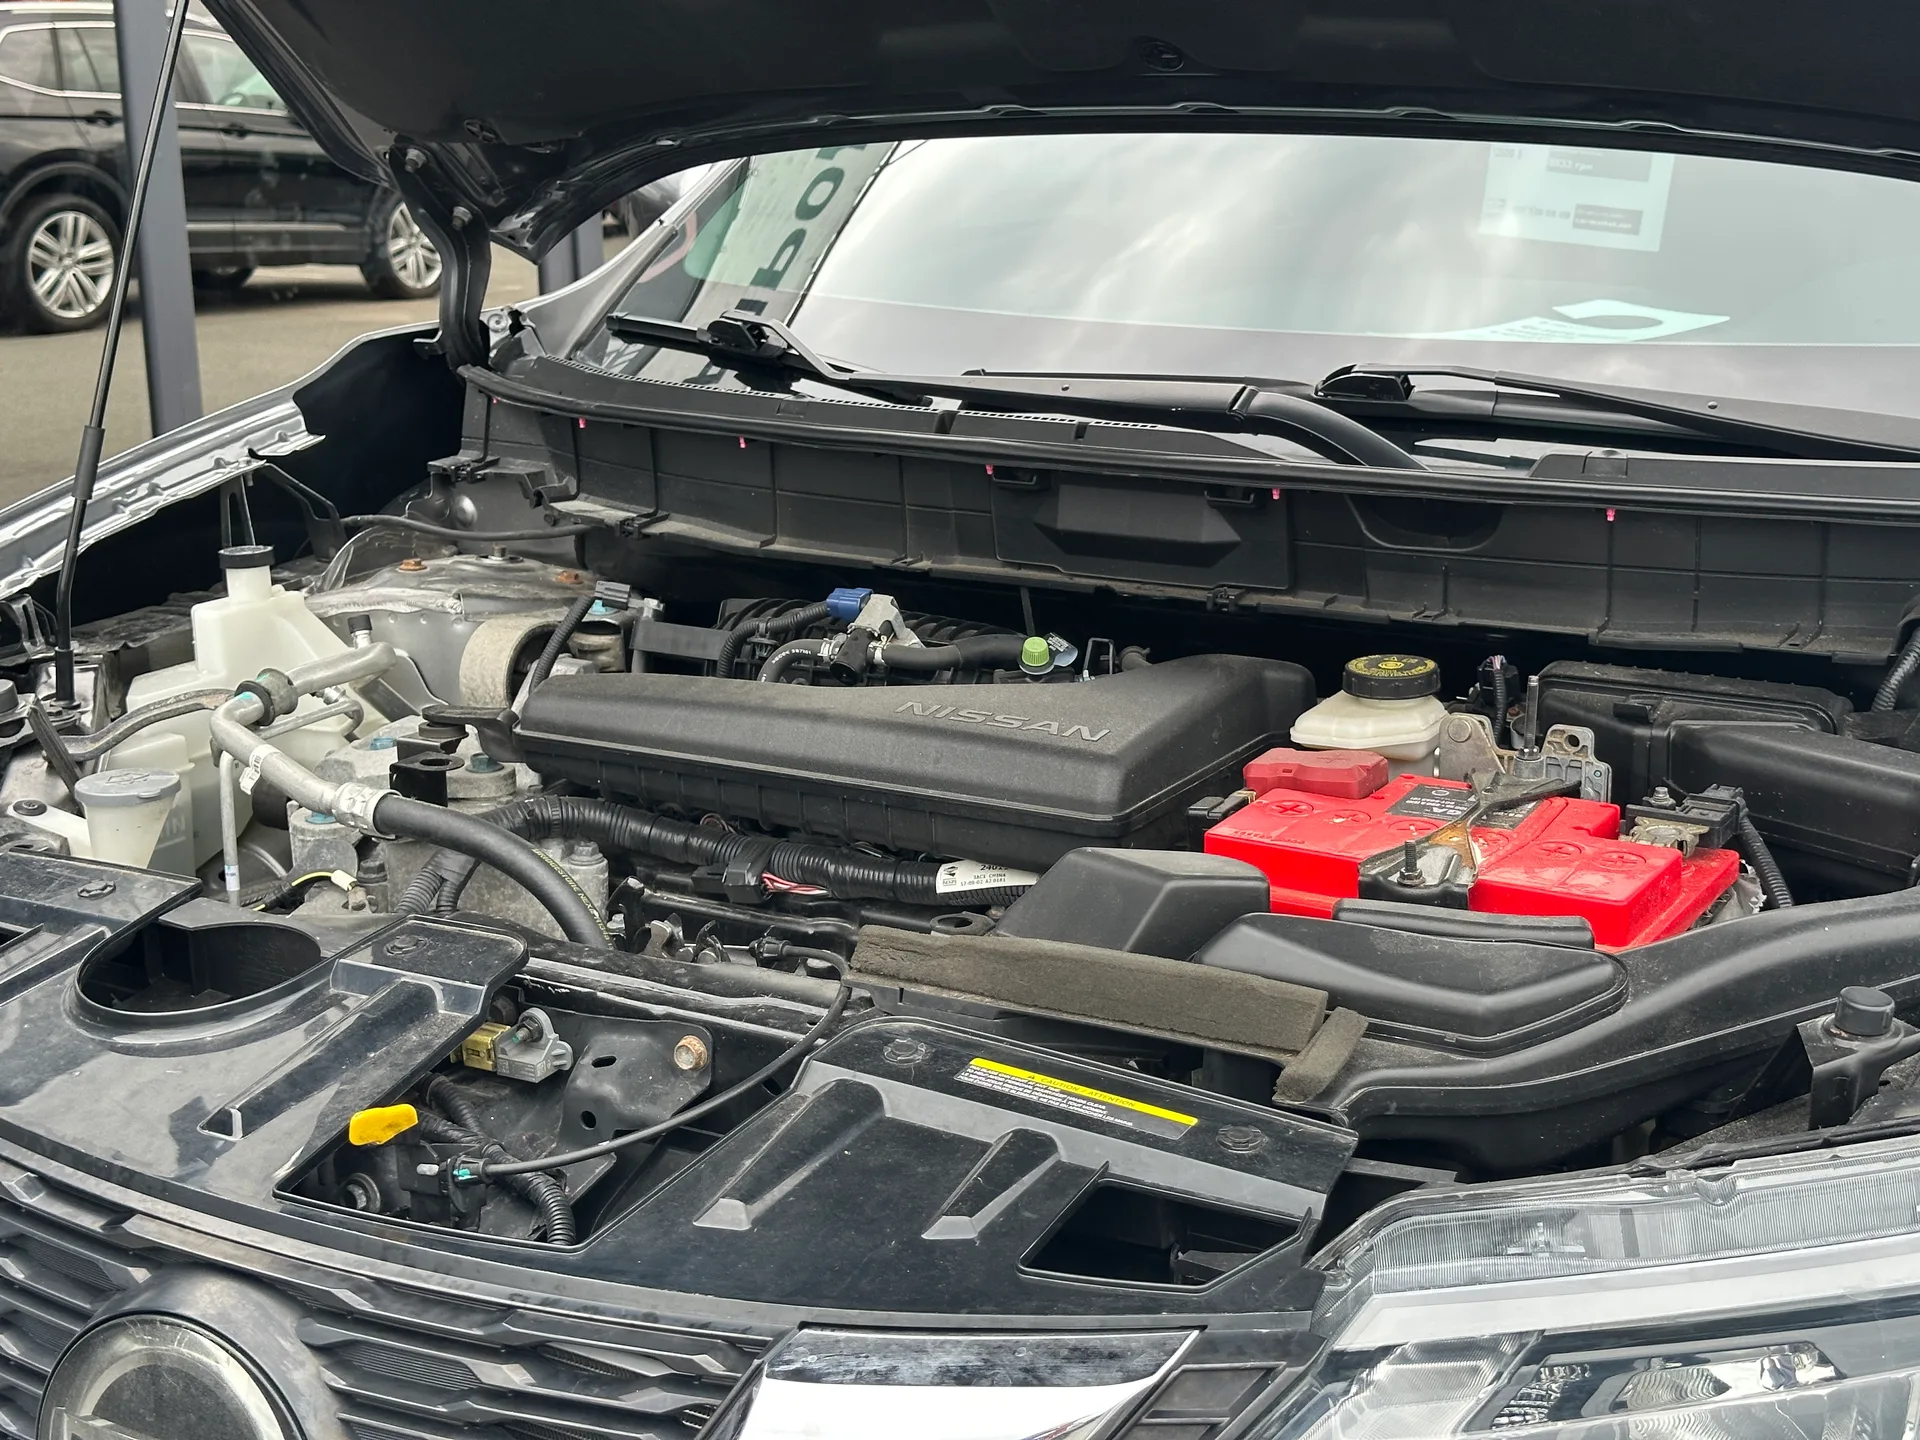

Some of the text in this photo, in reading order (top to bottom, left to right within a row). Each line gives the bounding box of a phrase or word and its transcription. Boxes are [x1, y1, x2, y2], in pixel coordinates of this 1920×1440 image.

[894, 701, 1112, 742] NISSAN
[1041, 1078, 1079, 1092] CAUTION
[1088, 1090, 1136, 1107] ATTENTION
